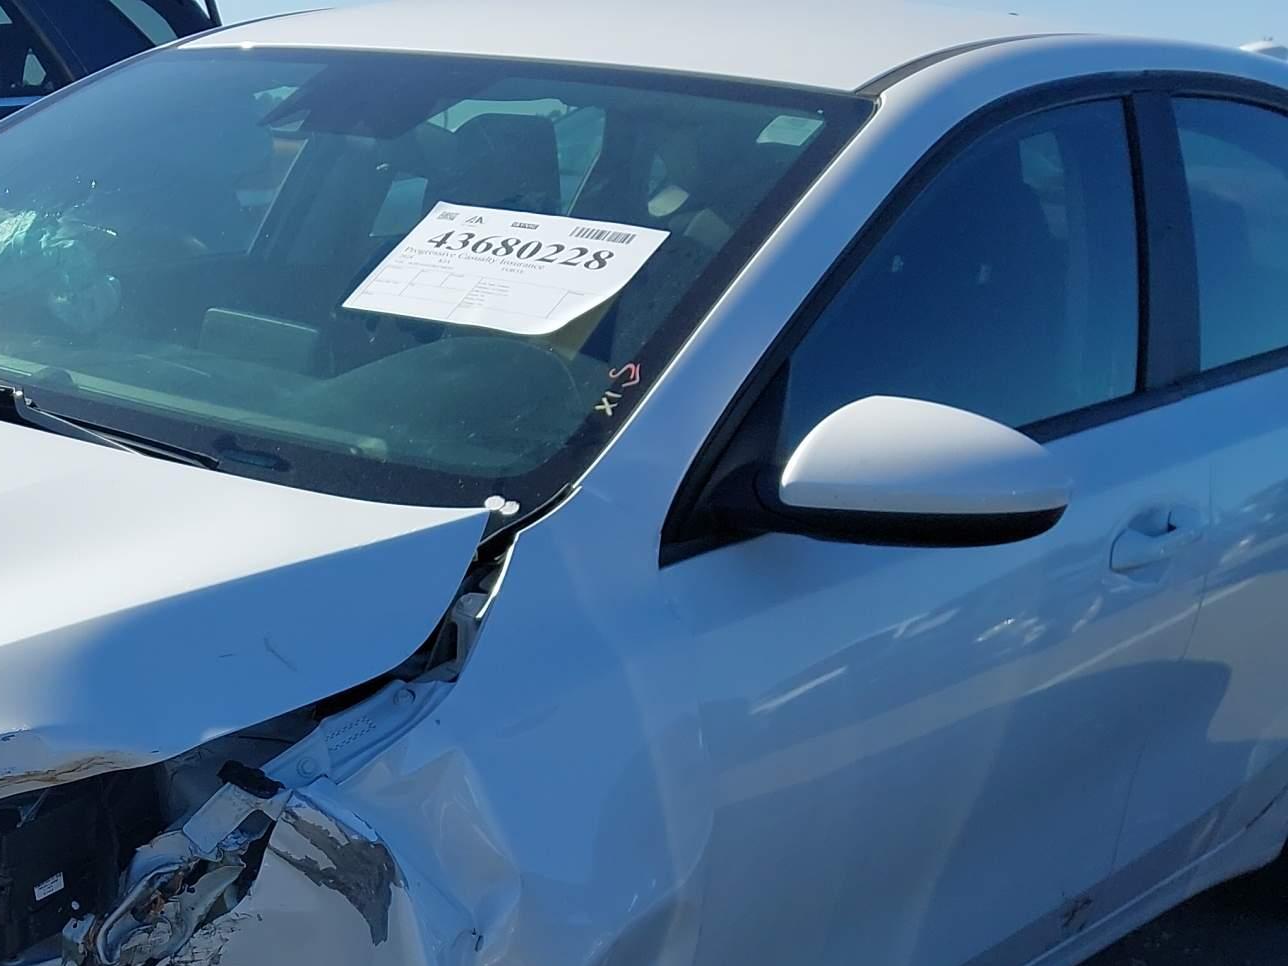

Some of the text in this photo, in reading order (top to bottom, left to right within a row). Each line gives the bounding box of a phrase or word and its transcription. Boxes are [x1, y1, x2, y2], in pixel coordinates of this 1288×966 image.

[404, 246, 545, 270] Progressive Casualty Insurance
[426, 229, 615, 271] 43680228
